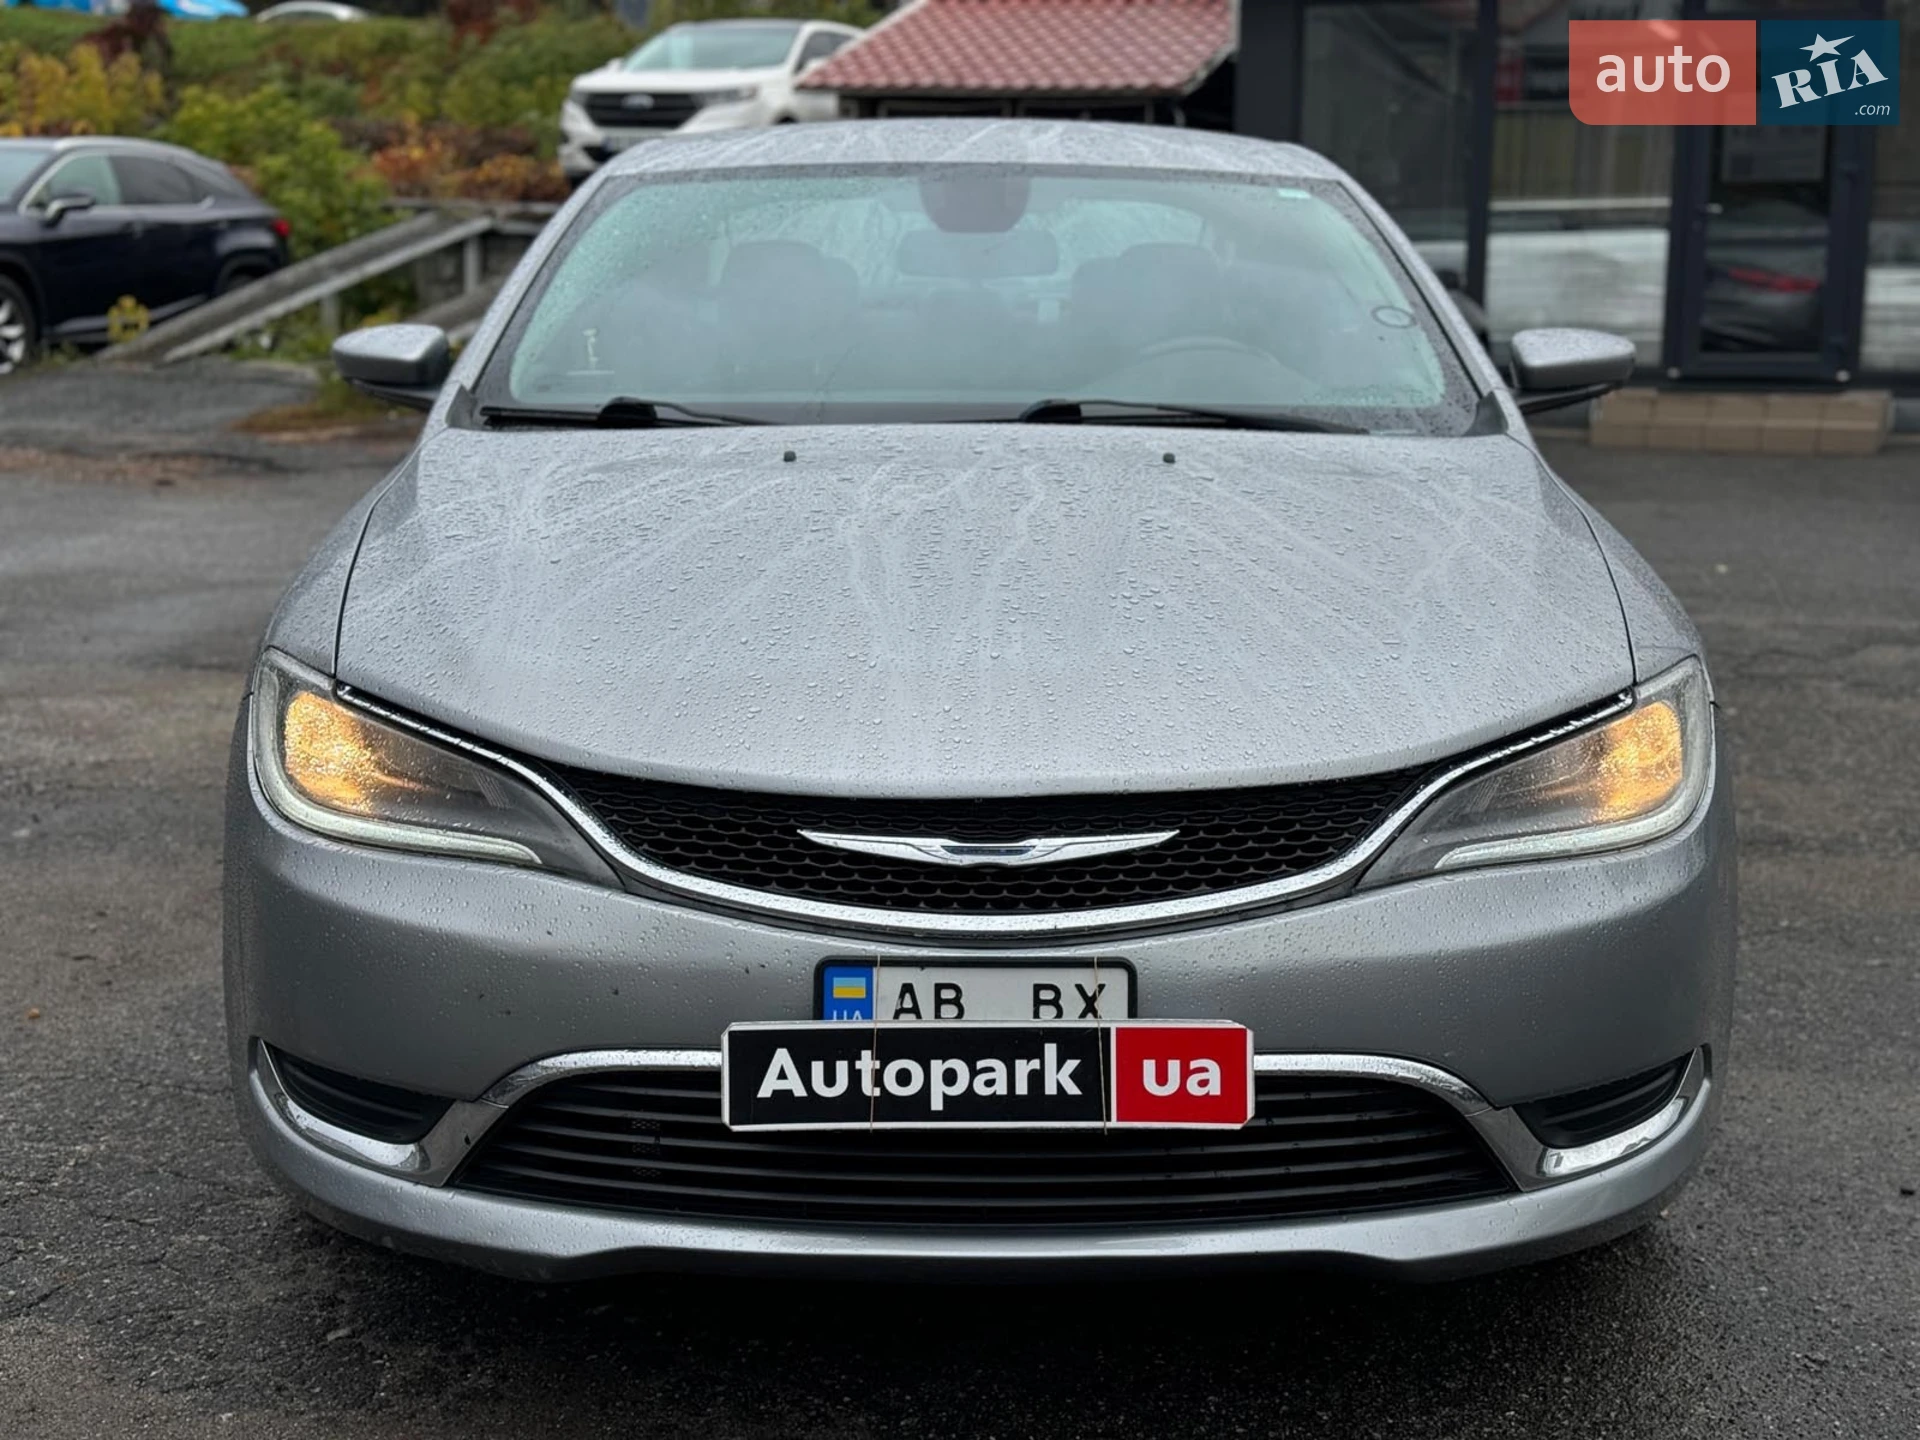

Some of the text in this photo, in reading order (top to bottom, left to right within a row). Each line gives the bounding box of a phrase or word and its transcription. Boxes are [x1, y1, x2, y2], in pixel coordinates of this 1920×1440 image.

[892, 982, 1107, 1020] AB BX
[756, 1042, 1222, 1111] Autopark ua
